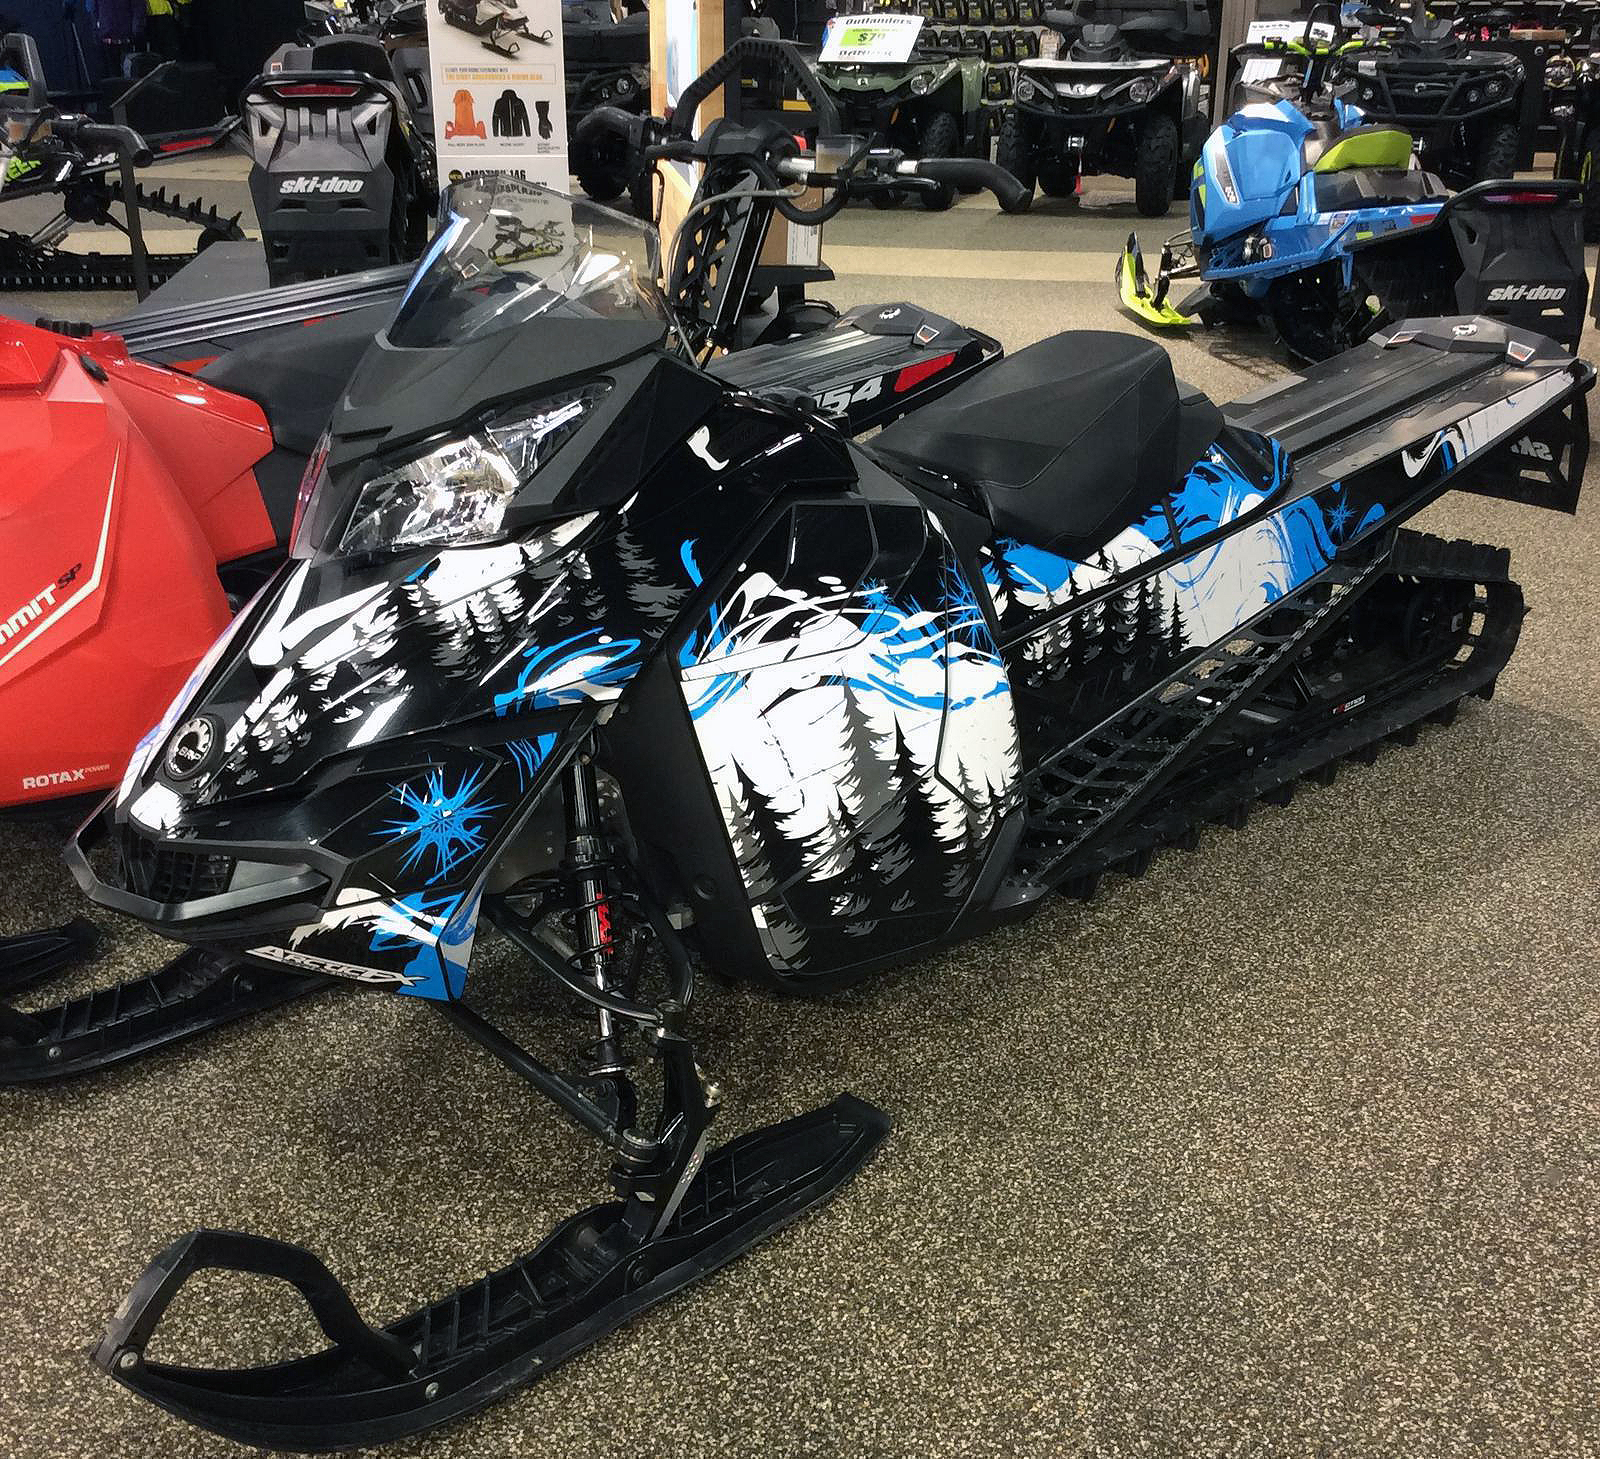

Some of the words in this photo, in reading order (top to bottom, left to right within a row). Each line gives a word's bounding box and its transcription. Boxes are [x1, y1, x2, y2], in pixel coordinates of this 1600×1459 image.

[845, 17, 912, 25] Outlanders
[279, 176, 364, 194] ski-doo
[1487, 284, 1567, 301] ski-doo
[178, 746, 202, 761] BRP
[22, 768, 86, 790] ROTAX
